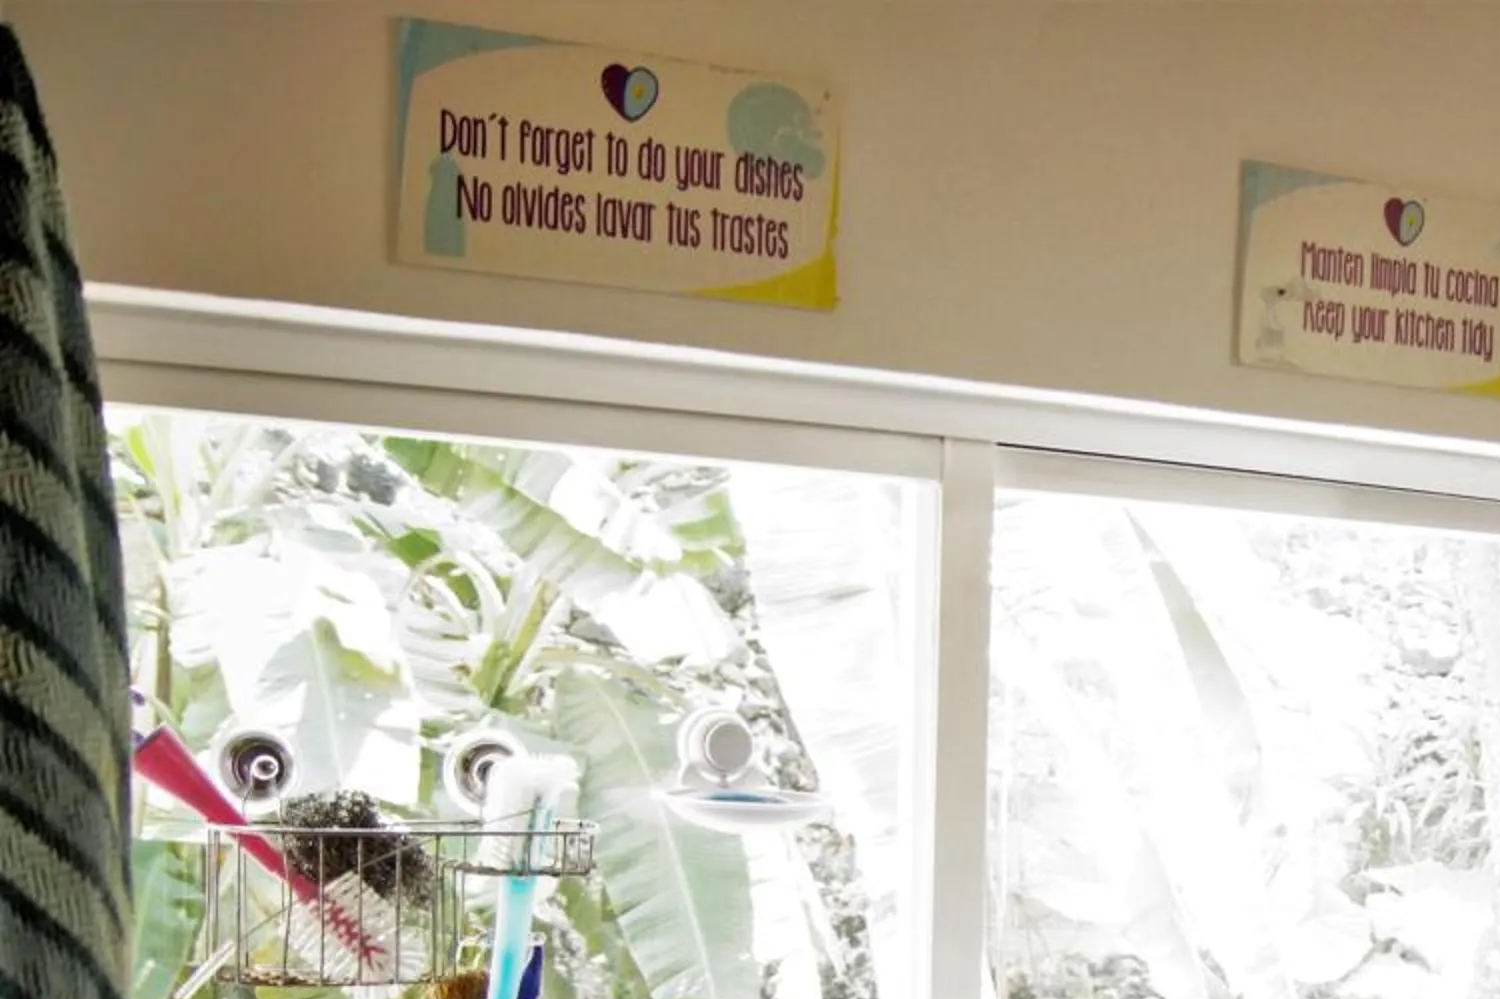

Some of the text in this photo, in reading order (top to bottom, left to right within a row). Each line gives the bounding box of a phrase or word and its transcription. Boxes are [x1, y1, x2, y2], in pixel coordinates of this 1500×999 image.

[519, 120, 595, 175] forget
[605, 132, 629, 177] to
[638, 137, 666, 182] do
[675, 146, 724, 191] your
[735, 152, 803, 202] dishes
[456, 175, 788, 259] No olvides lavar tus trastes
[1301, 241, 1500, 309] Manten limpia tu cocina
[1352, 307, 1389, 344] your
[1395, 308, 1454, 353] kitchen
[1461, 318, 1494, 362] tidy
